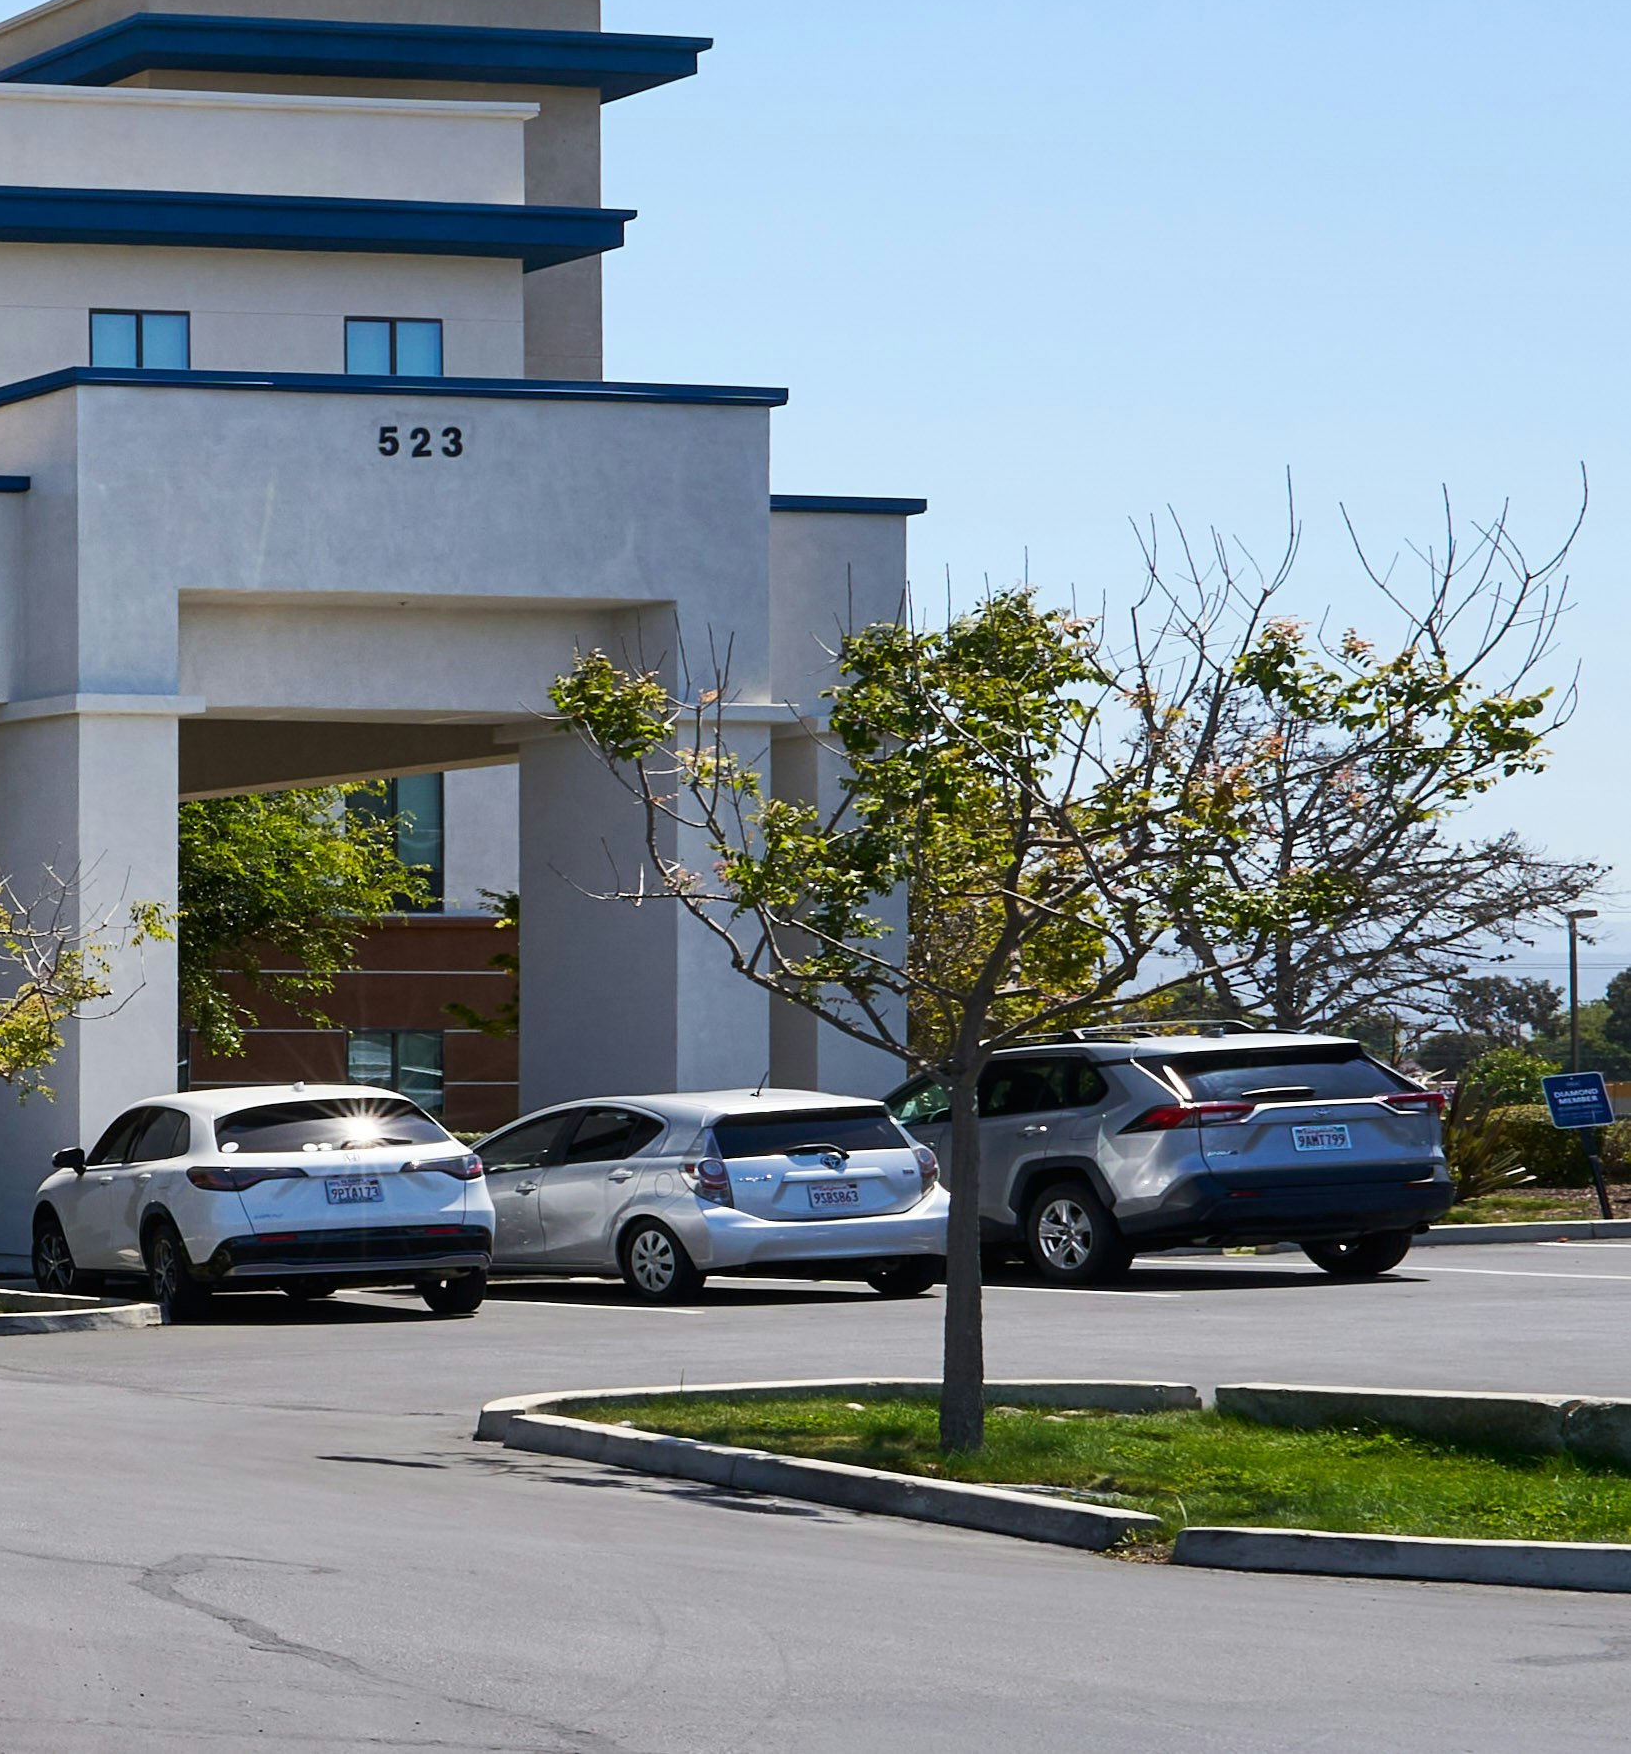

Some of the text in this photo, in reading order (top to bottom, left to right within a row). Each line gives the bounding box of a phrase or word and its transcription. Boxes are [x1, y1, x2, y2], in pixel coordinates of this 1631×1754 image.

[379, 426, 463, 457] 523
[1553, 1088, 1599, 1099] DIAMOND
[331, 1186, 379, 1199] 9PIA173
